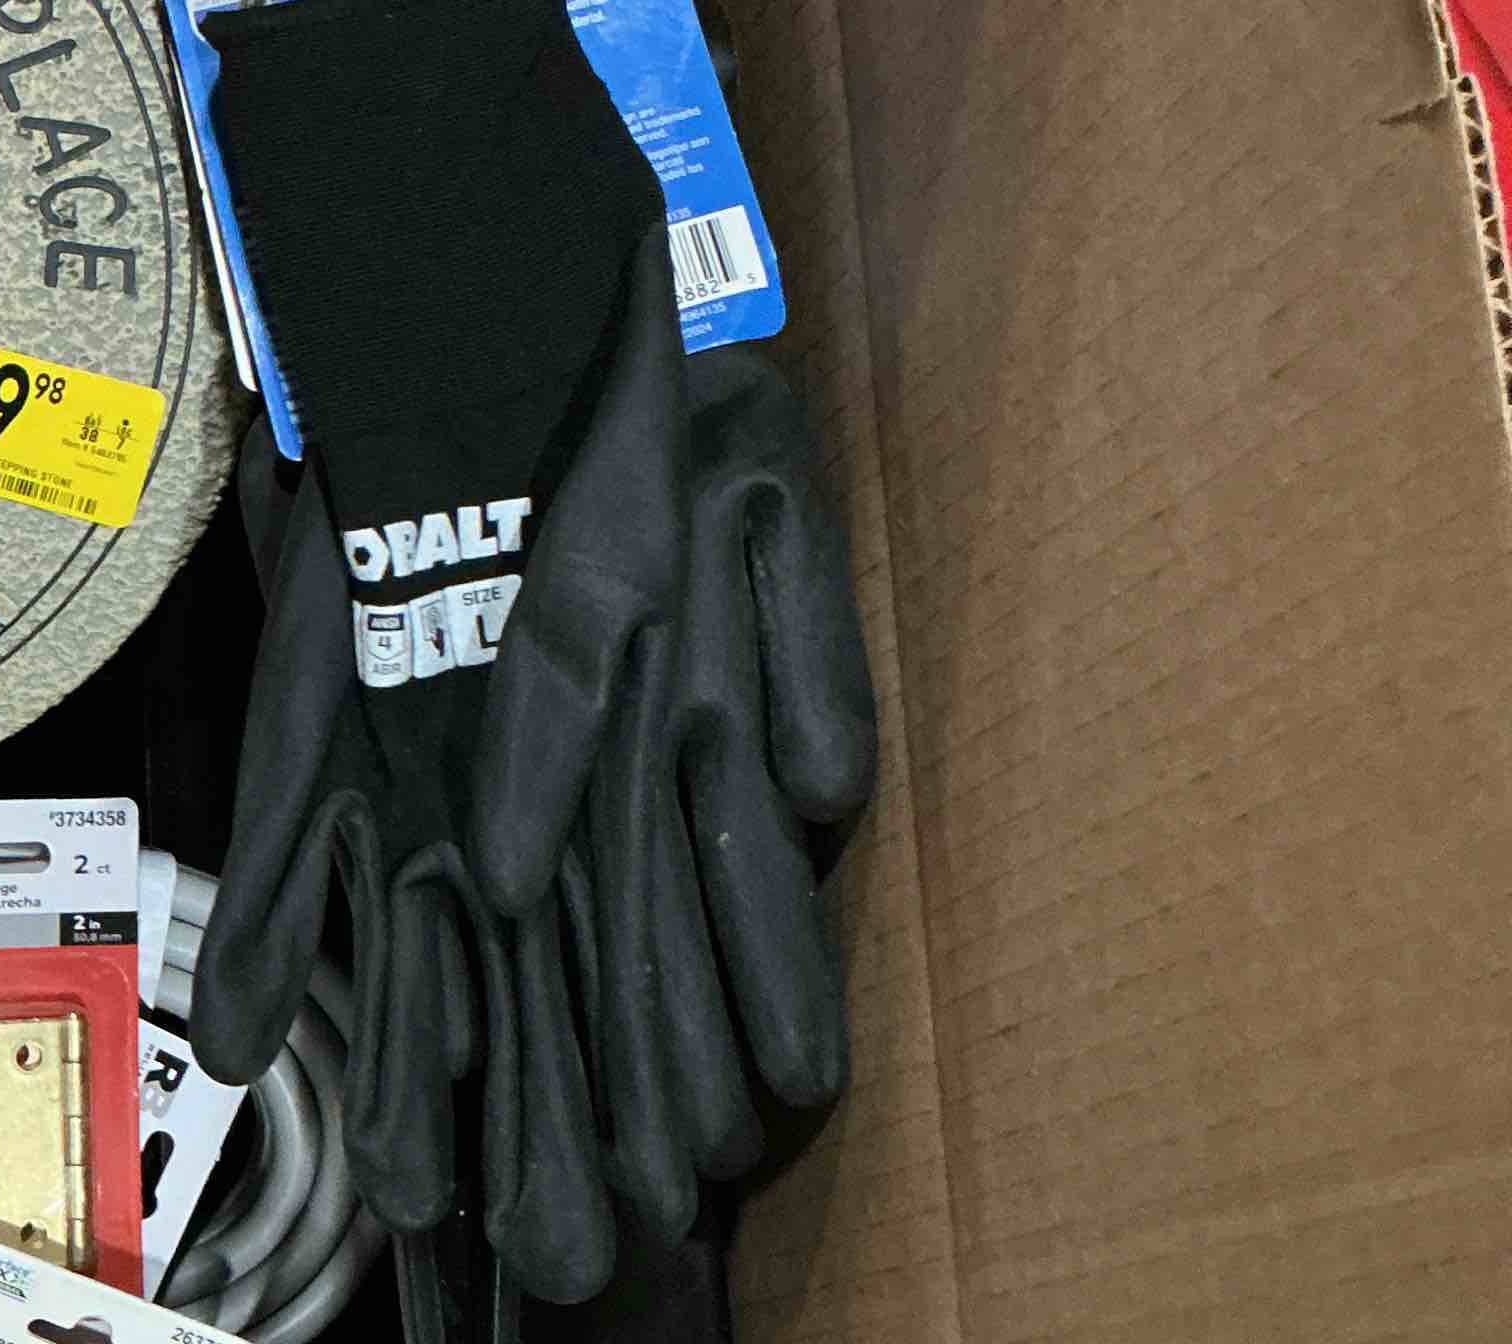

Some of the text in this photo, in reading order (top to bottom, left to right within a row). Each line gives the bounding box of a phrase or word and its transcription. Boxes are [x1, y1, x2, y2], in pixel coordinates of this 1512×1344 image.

[40, 469, 73, 489] STONE
[343, 496, 532, 583] OBALT
[461, 585, 504, 607] SIZE
[48, 810, 127, 828] #3734358
[73, 855, 89, 875] 2
[72, 914, 86, 930] 2
